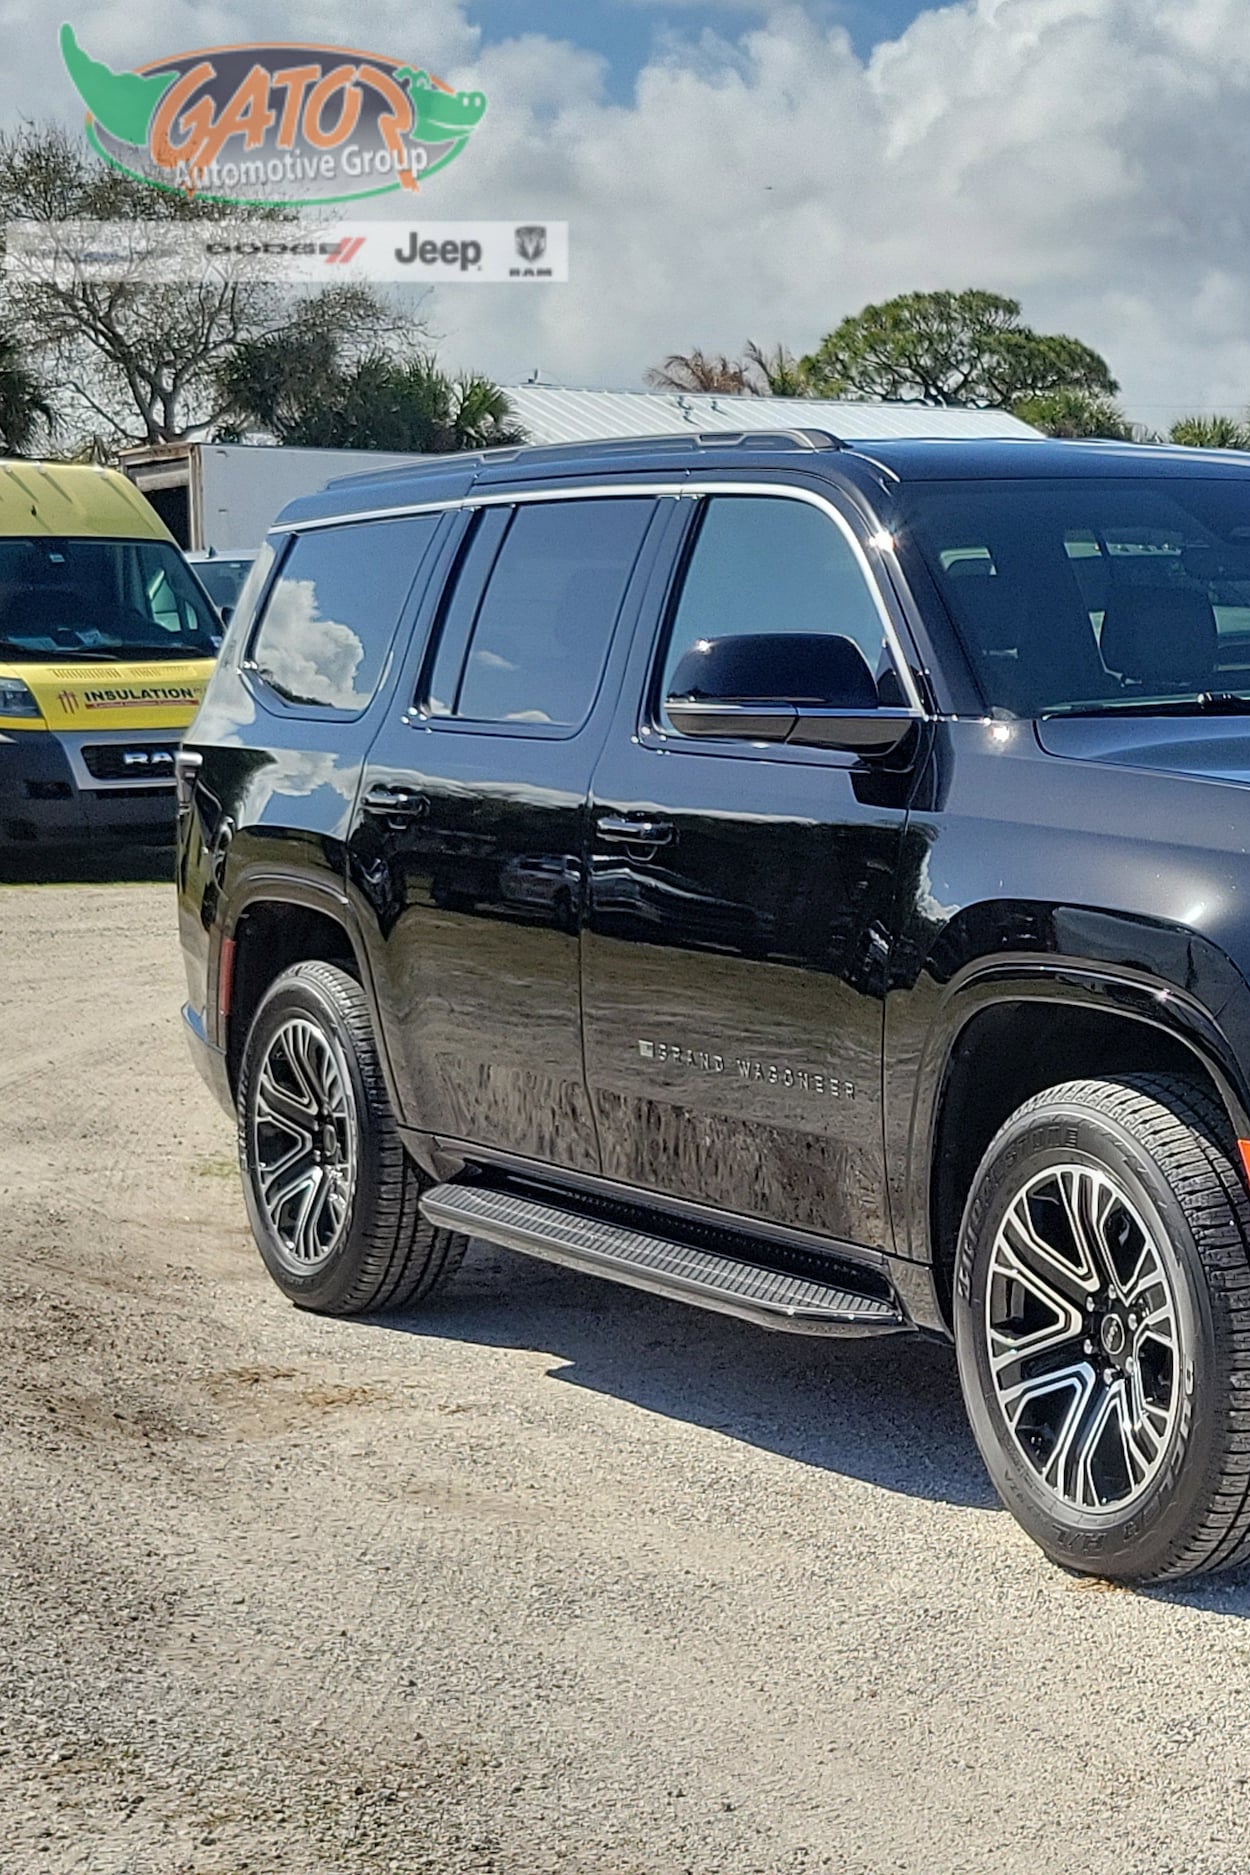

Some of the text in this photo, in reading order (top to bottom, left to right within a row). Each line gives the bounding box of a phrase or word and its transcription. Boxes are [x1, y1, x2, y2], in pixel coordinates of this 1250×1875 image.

[84, 688, 194, 702] INSULATION
[123, 752, 175, 765] RA
[658, 1043, 856, 1100] GRAND WAGONEER
